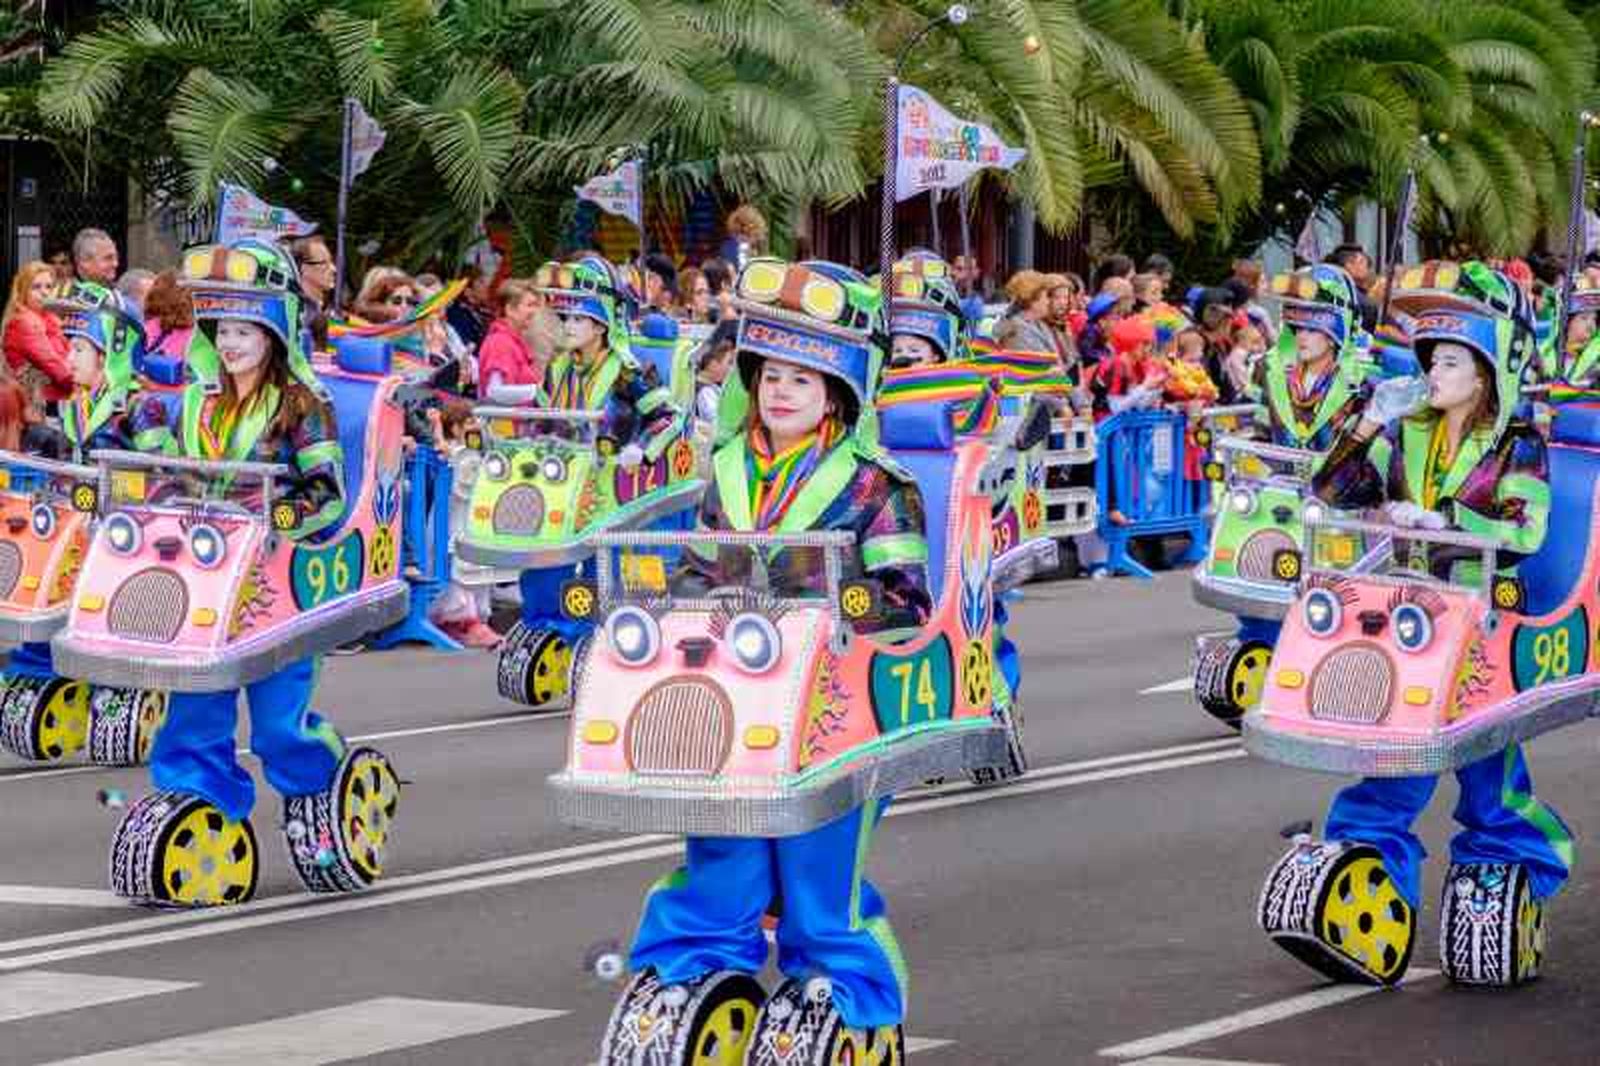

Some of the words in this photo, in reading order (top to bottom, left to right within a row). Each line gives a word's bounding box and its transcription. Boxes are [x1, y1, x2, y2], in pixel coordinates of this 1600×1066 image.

[307, 544, 350, 605] 96
[1534, 627, 1569, 686] 98
[890, 656, 937, 725] 74
